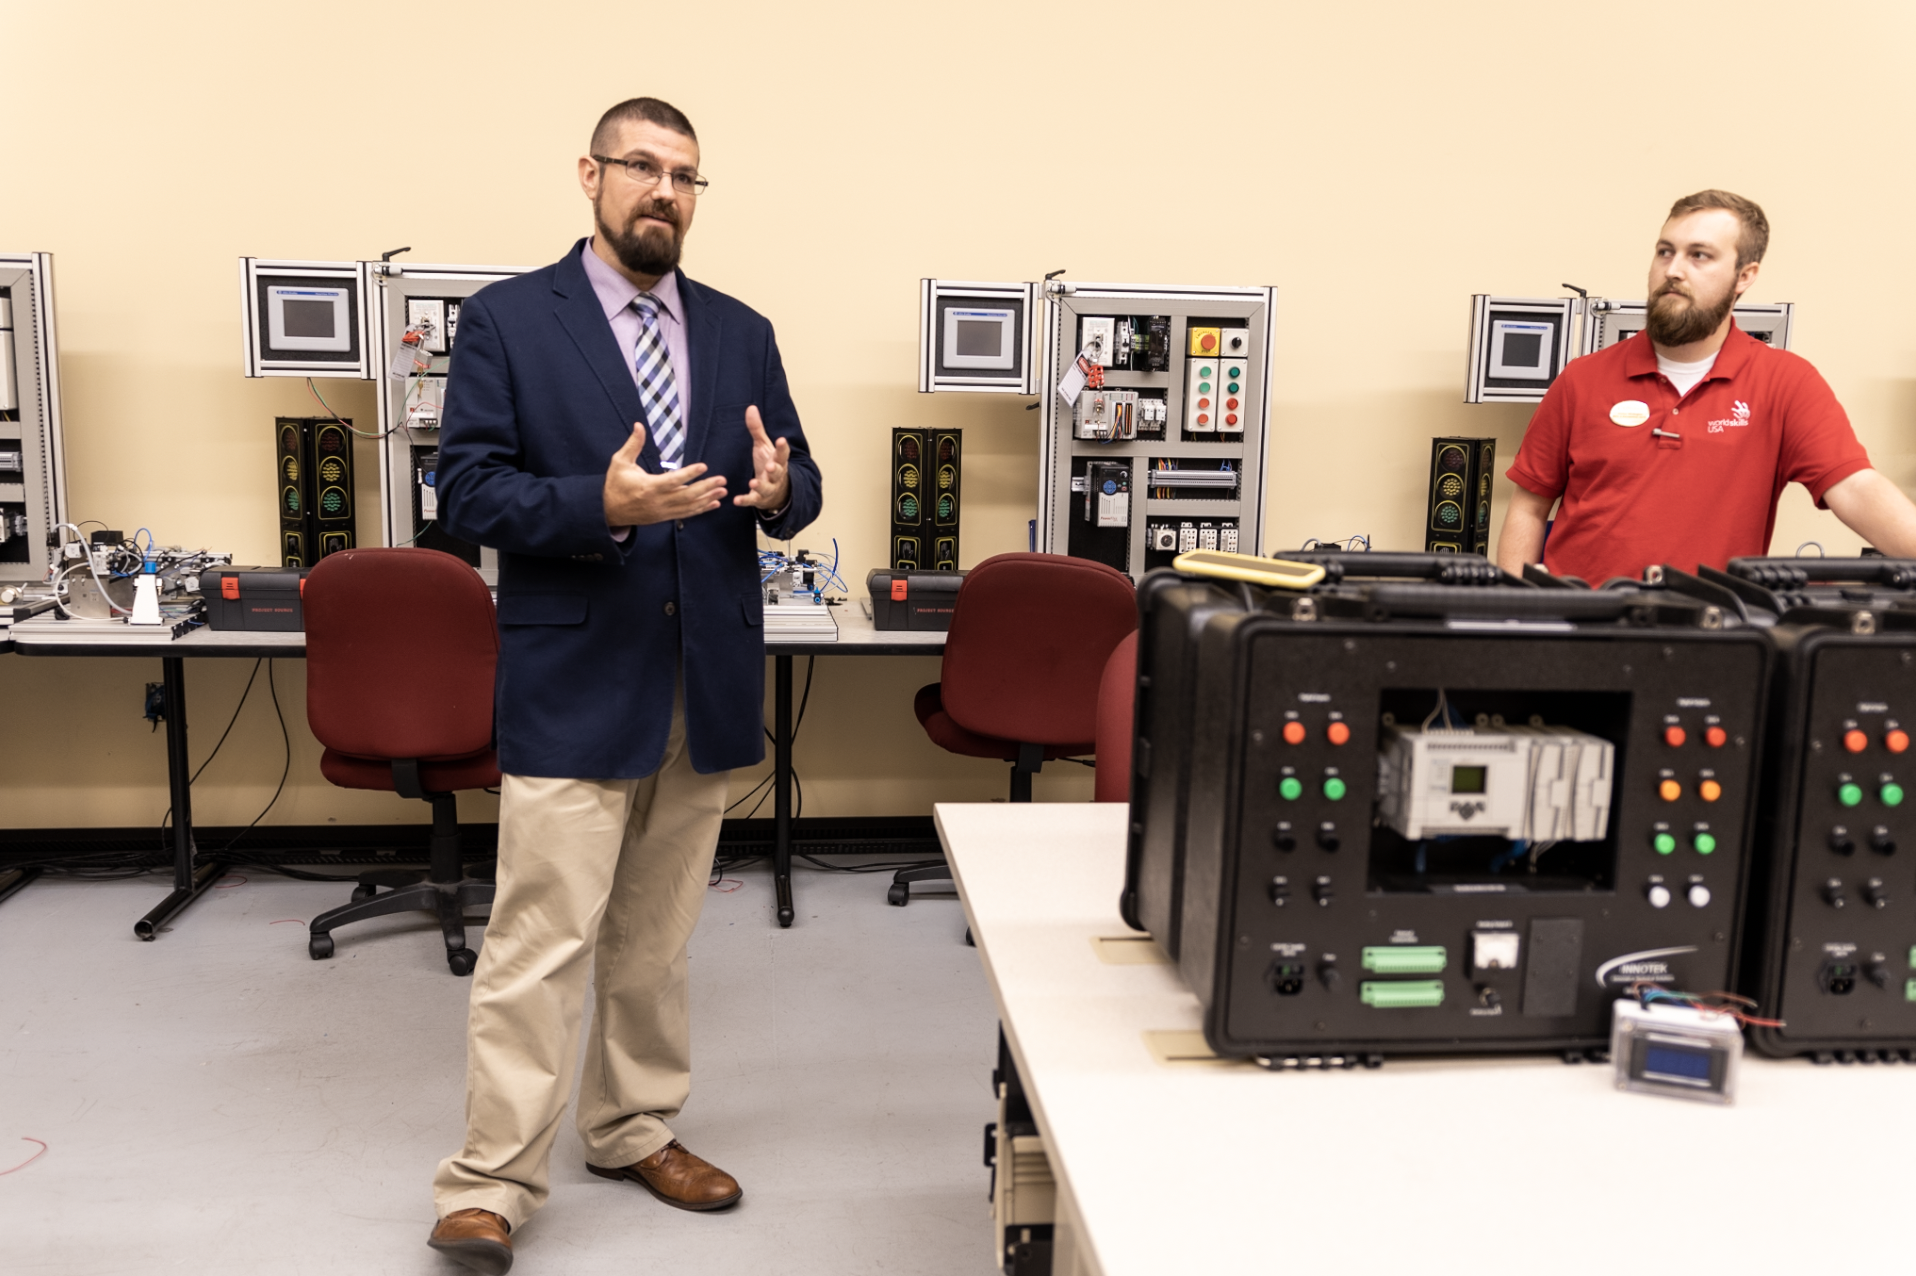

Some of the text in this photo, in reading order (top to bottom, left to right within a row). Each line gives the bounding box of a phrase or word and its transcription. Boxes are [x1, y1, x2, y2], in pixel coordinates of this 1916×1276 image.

[1707, 418, 1749, 427] worldskills
[1707, 425, 1724, 433] USA
[1619, 963, 1668, 975] INNOTEK
